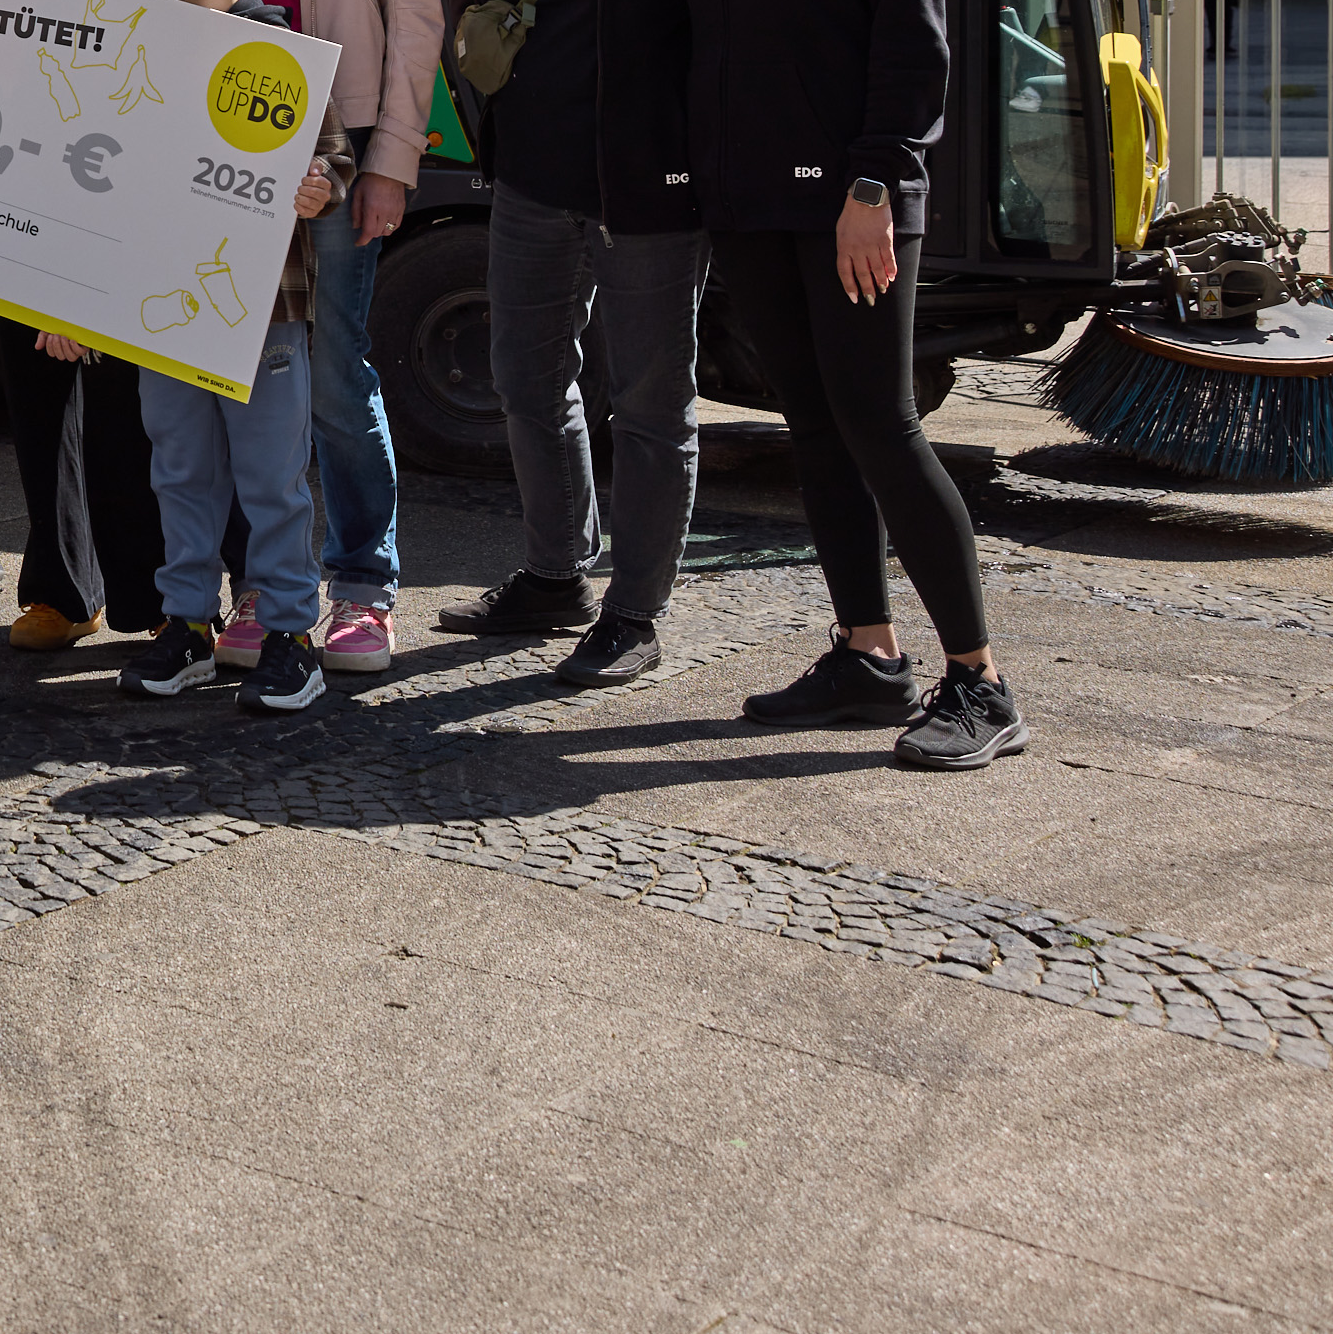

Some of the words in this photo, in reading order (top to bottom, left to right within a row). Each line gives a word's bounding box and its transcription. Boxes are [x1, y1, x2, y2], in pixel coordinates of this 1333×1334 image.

[221, 65, 301, 106] #CLEAN
[62, 132, 123, 194] €
[794, 166, 823, 178] EDG
[192, 157, 277, 205] 2026
[665, 172, 690, 185] EDG
[196, 374, 209, 384] WIR
[209, 377, 224, 389] SIND
[224, 384, 236, 393] DA.
